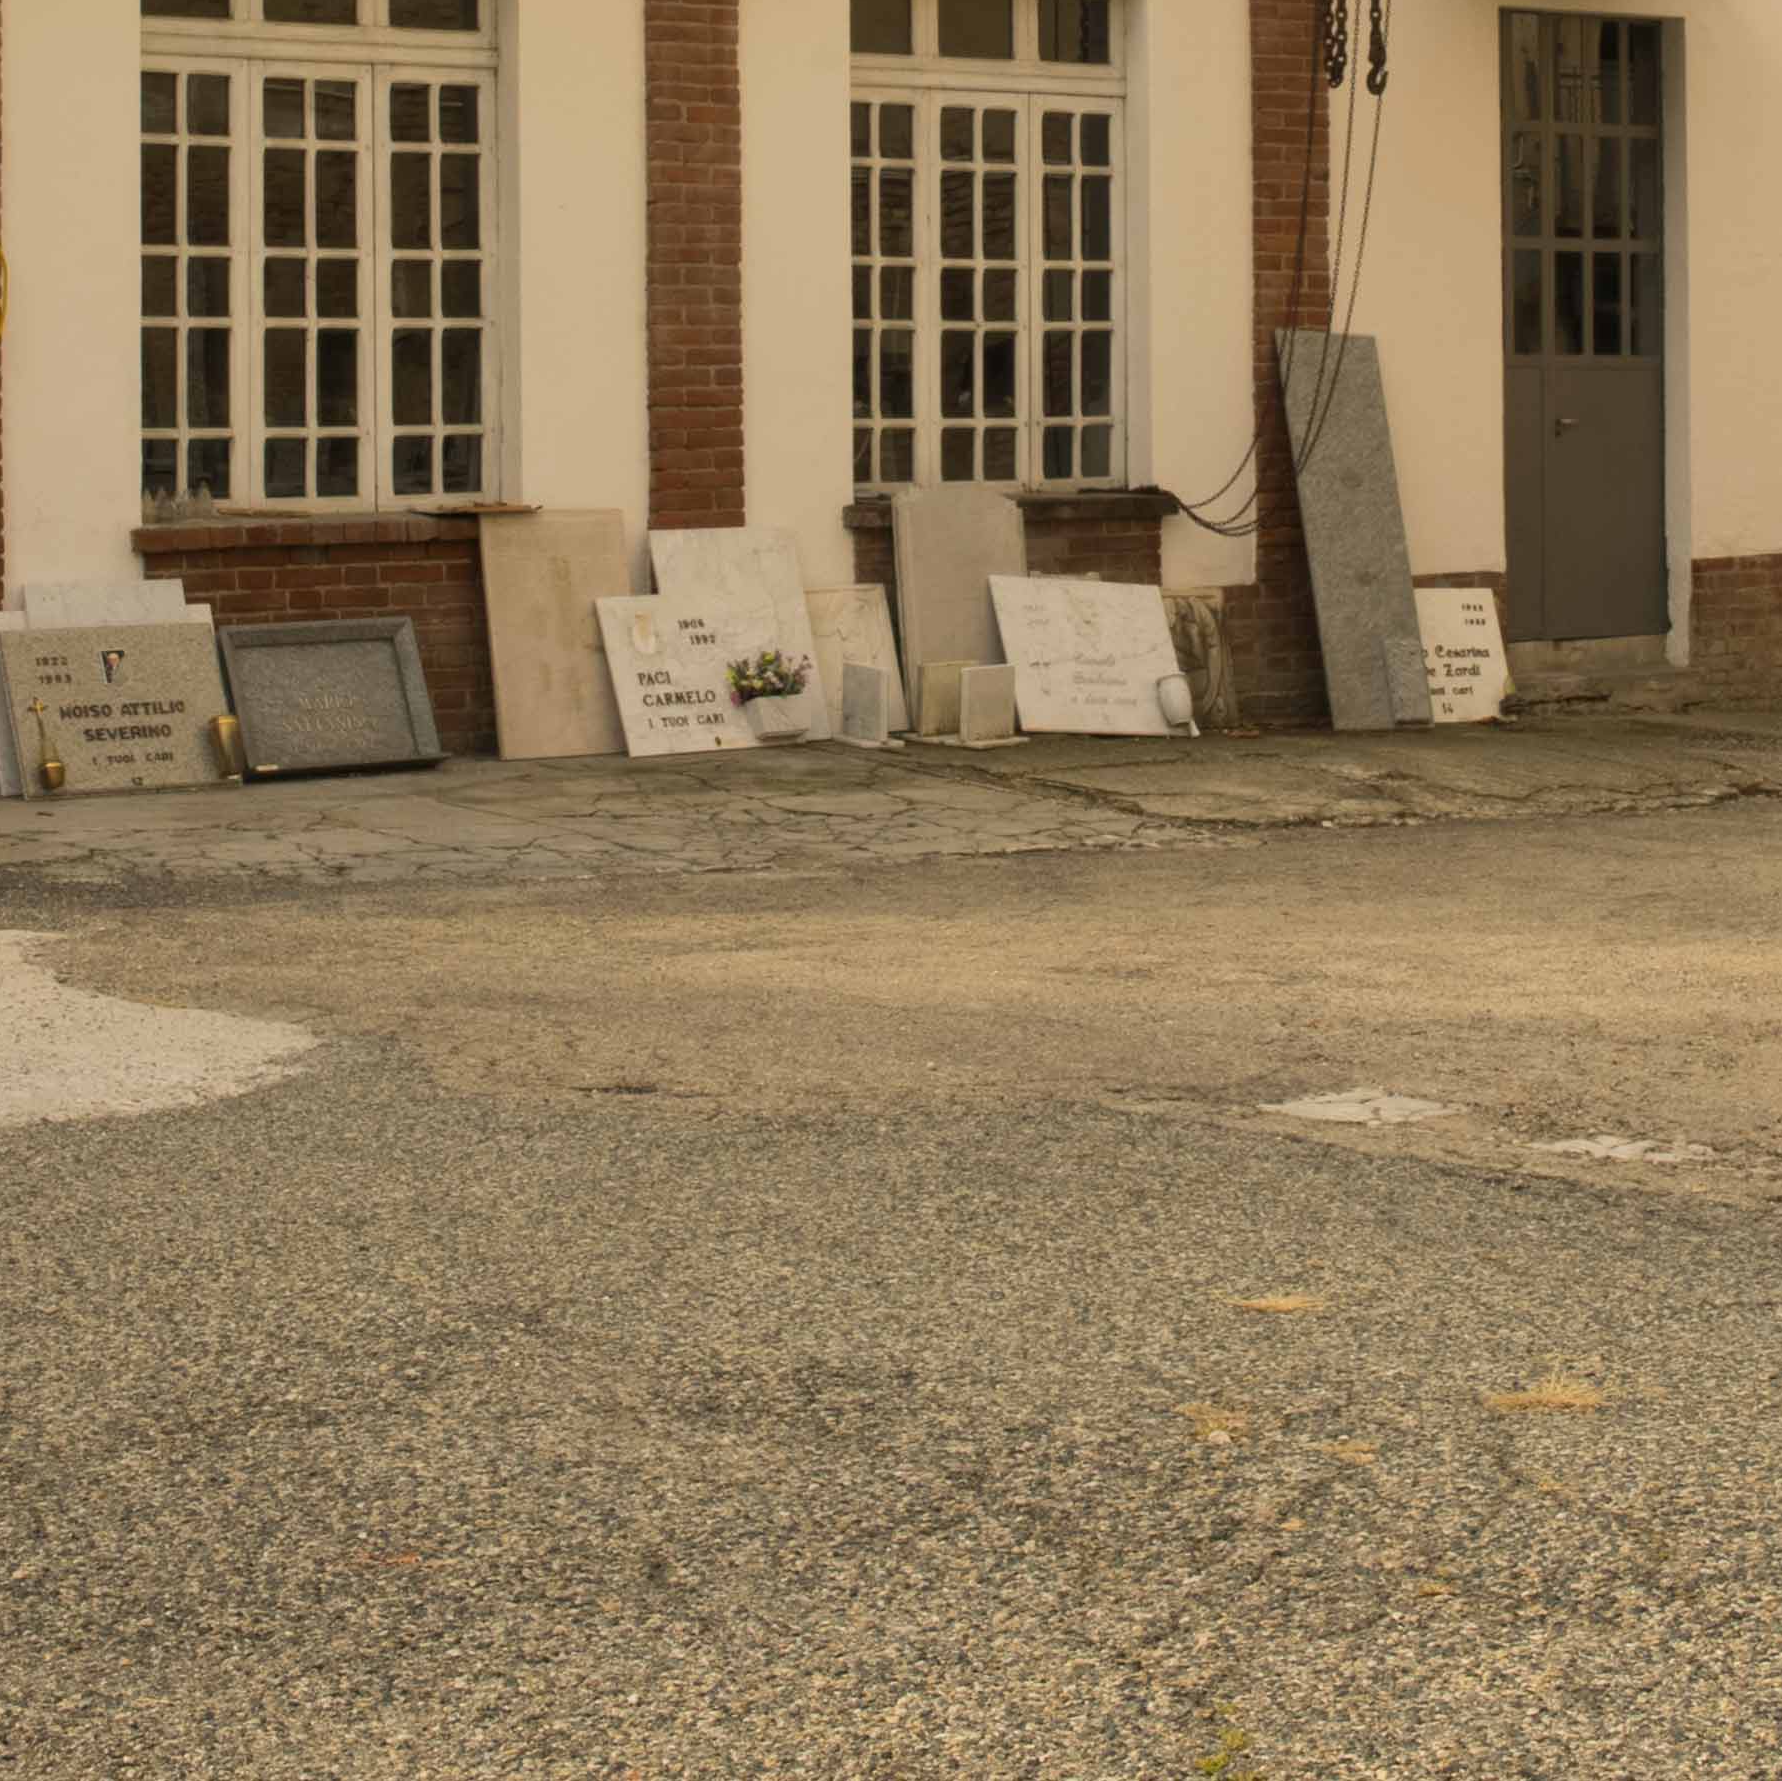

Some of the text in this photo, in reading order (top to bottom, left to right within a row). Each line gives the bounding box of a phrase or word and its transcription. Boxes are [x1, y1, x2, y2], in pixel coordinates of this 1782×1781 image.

[1435, 644, 1490, 658] Cesarina
[637, 671, 672, 686] PACI
[642, 690, 716, 707] CARMELO
[121, 700, 185, 716] ATTILIO
[660, 716, 690, 728] TUOI
[696, 713, 726, 725] CARI
[83, 724, 171, 742] SEVERINO
